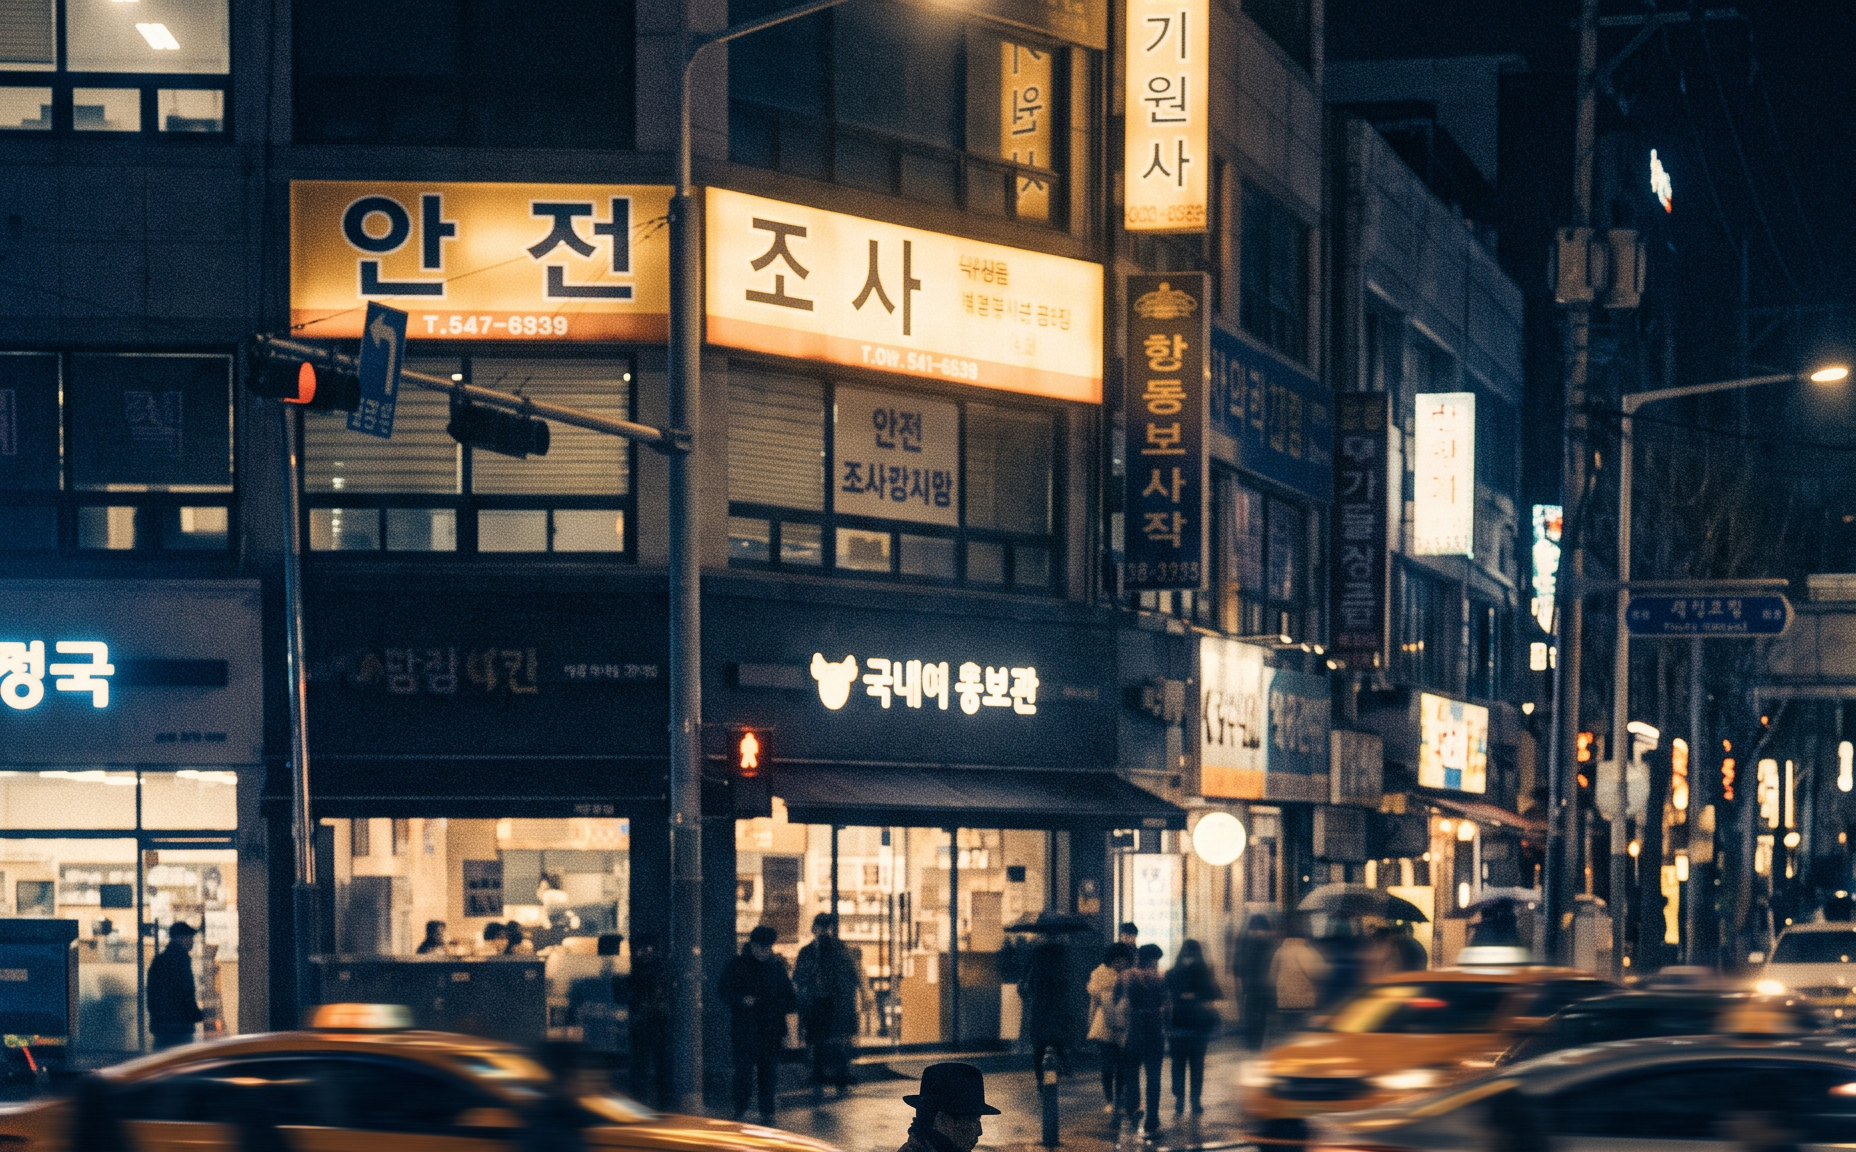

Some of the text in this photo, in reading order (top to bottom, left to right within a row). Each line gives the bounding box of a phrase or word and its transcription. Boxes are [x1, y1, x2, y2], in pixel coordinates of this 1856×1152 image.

[341, 193, 636, 300] 안전
[744, 216, 922, 337] 조사
[872, 408, 923, 453] 안전
